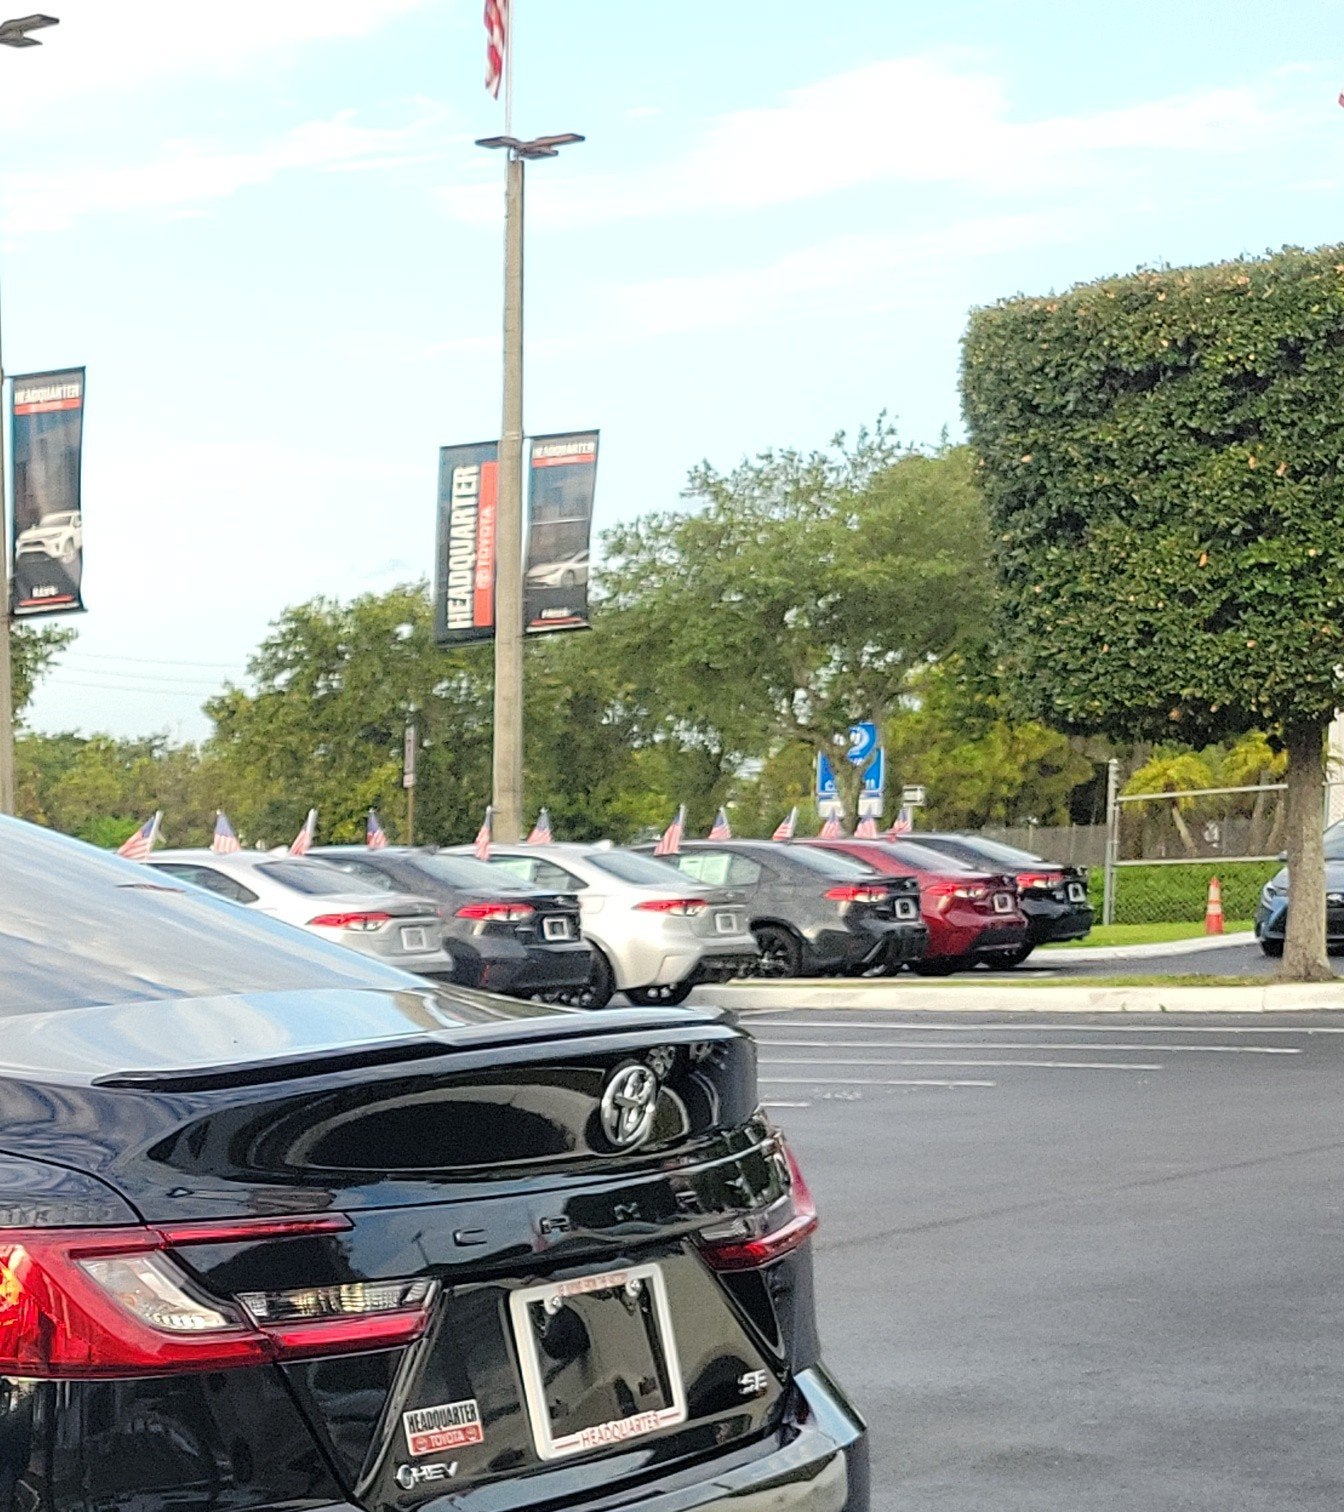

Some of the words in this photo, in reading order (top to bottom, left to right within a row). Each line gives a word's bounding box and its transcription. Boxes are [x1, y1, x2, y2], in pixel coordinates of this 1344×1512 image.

[447, 464, 480, 629] HEADQUARTER
[737, 1369, 767, 1395] SE
[407, 1403, 477, 1434] HEADQUARTER
[581, 1413, 660, 1449] HEADQUARTER
[428, 1429, 464, 1449] TOYOTA
